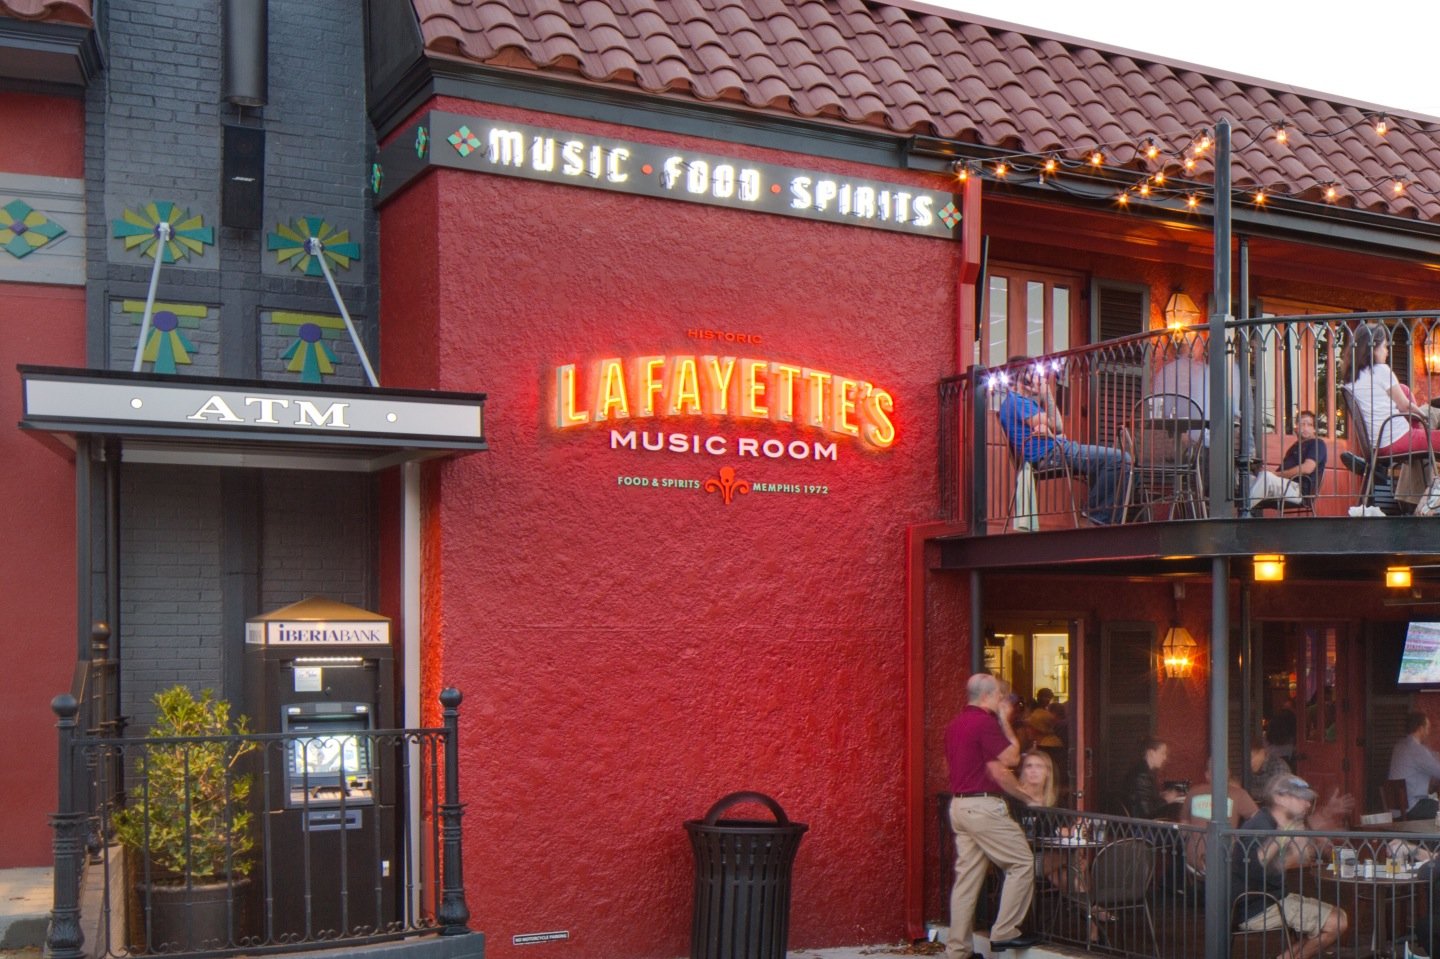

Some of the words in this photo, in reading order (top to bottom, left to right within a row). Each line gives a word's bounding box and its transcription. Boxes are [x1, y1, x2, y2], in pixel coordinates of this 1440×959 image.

[486, 126, 630, 183] MUSIC
[661, 155, 762, 202] FOOD
[790, 175, 934, 227] SPIRITS
[687, 328, 763, 345] HISTORIC
[187, 395, 351, 428] ATM
[556, 354, 896, 448] LAFAYETTE'S
[609, 429, 728, 456] MUSIC
[738, 437, 838, 461] ROOM
[617, 475, 650, 487] FOOD
[651, 477, 659, 488] &
[661, 477, 701, 490] SPIRITS
[752, 482, 801, 494] MEMPHIS
[803, 484, 829, 495] 1972
